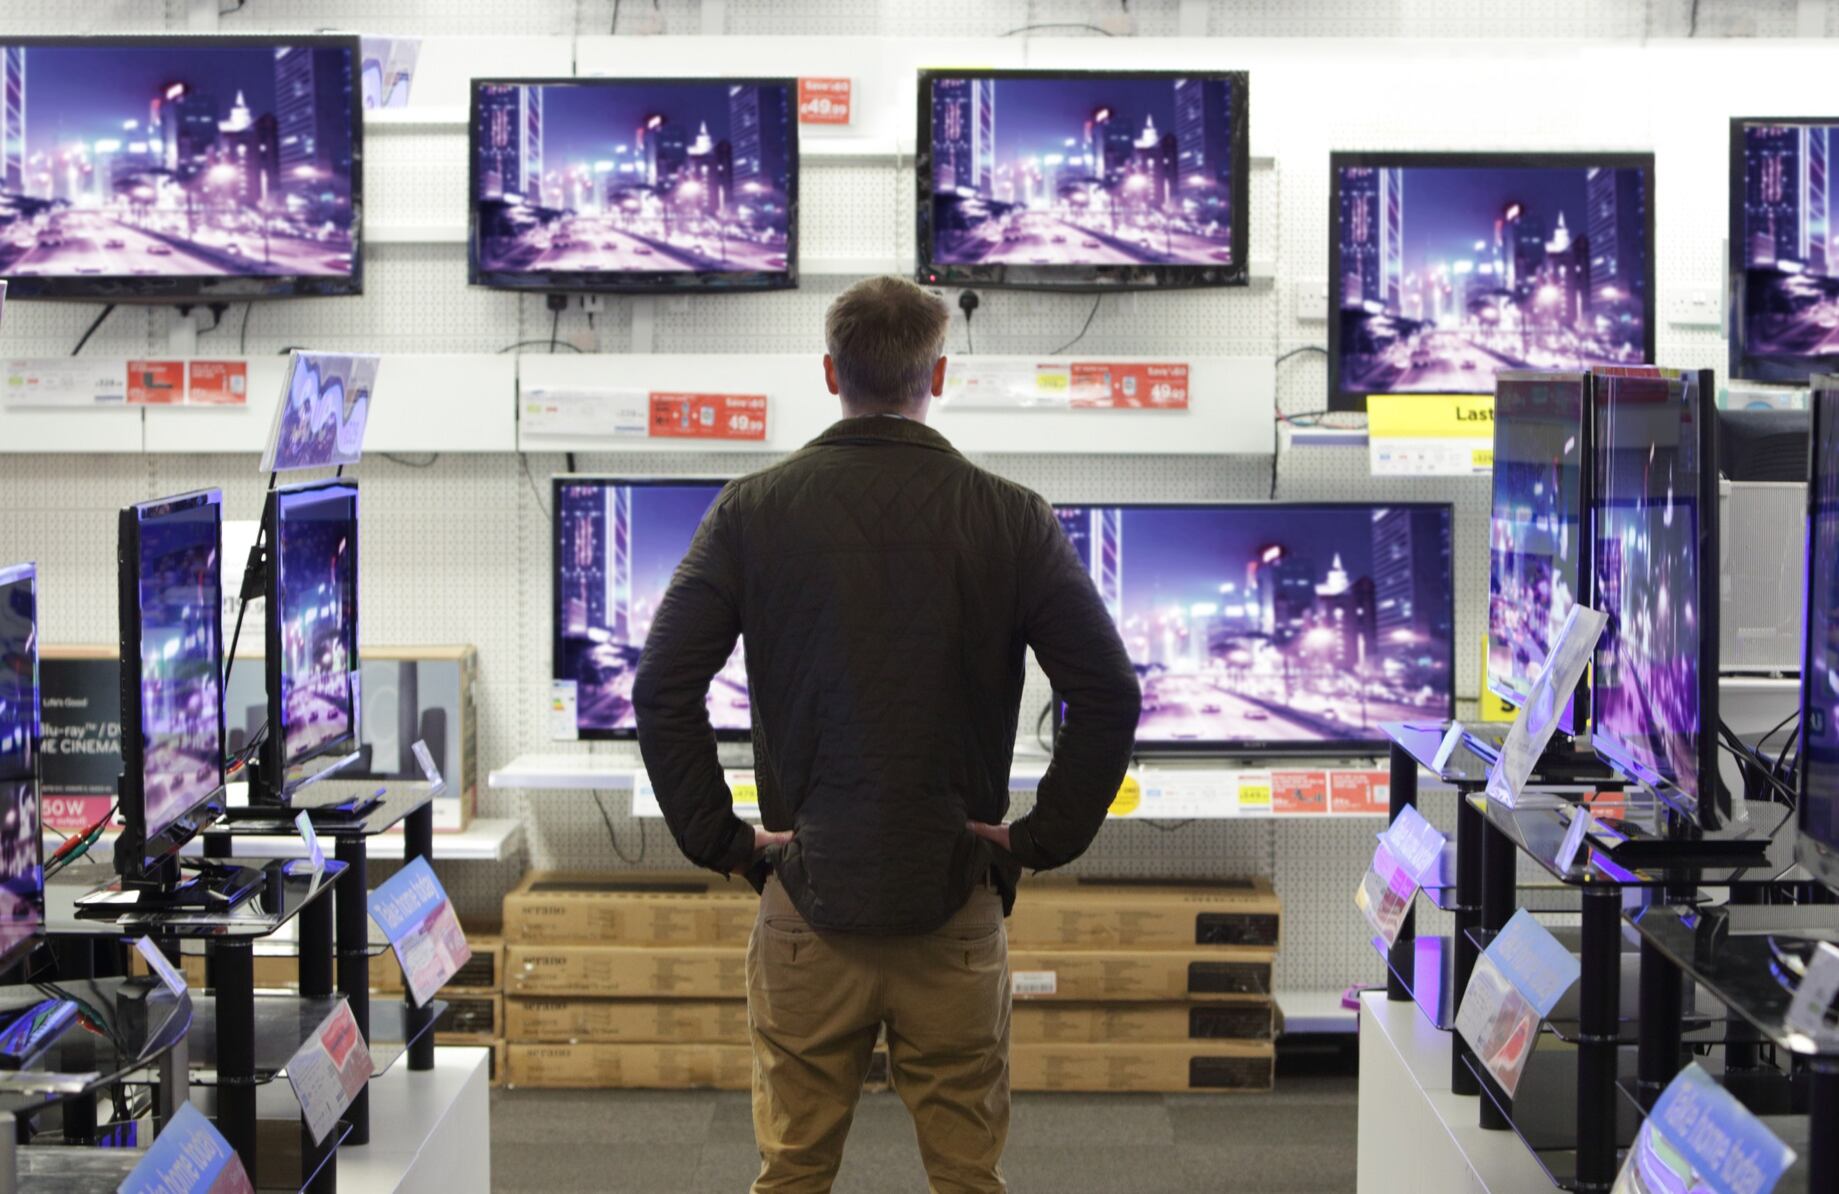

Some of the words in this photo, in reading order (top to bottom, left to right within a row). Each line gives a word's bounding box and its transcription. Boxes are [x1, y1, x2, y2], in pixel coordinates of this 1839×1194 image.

[1456, 406, 1493, 421] Last
[60, 738, 120, 754] CINEMA
[409, 872, 441, 904] today
[178, 1128, 225, 1172] today
